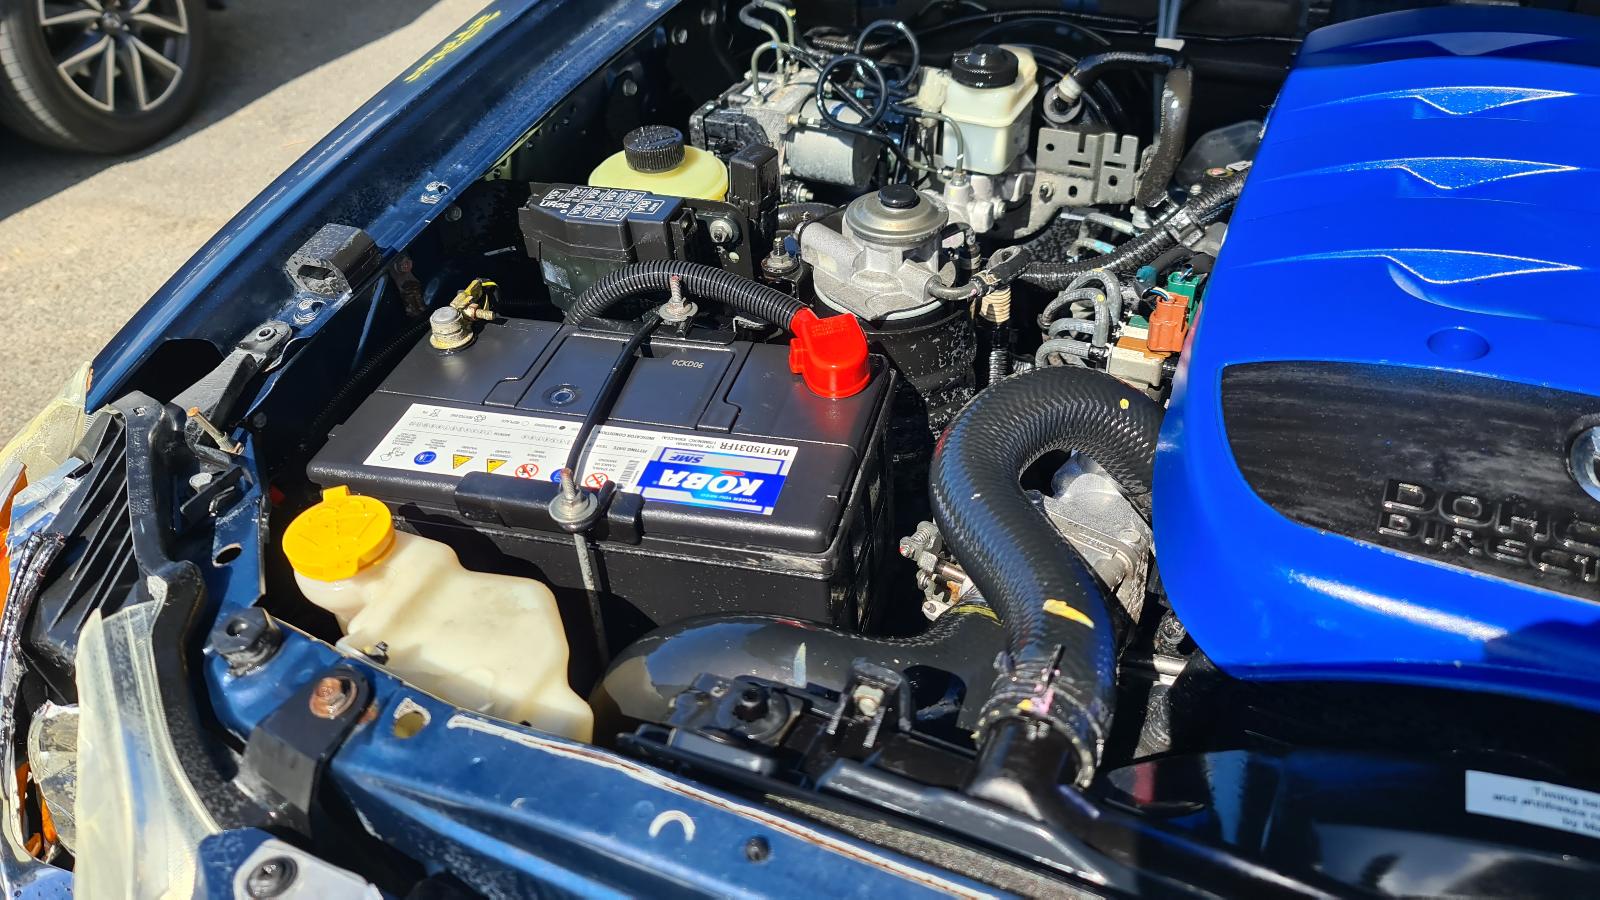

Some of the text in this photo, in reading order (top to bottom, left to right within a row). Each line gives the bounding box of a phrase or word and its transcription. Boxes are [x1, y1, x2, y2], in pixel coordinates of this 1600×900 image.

[719, 441, 791, 457] MF115D31FR
[668, 454, 705, 464] SMF
[658, 469, 764, 496] KOBA
[732, 495, 758, 504] POWER
[1492, 792, 1518, 805] and
[1532, 786, 1579, 805] Timing
[1561, 815, 1578, 828] by
